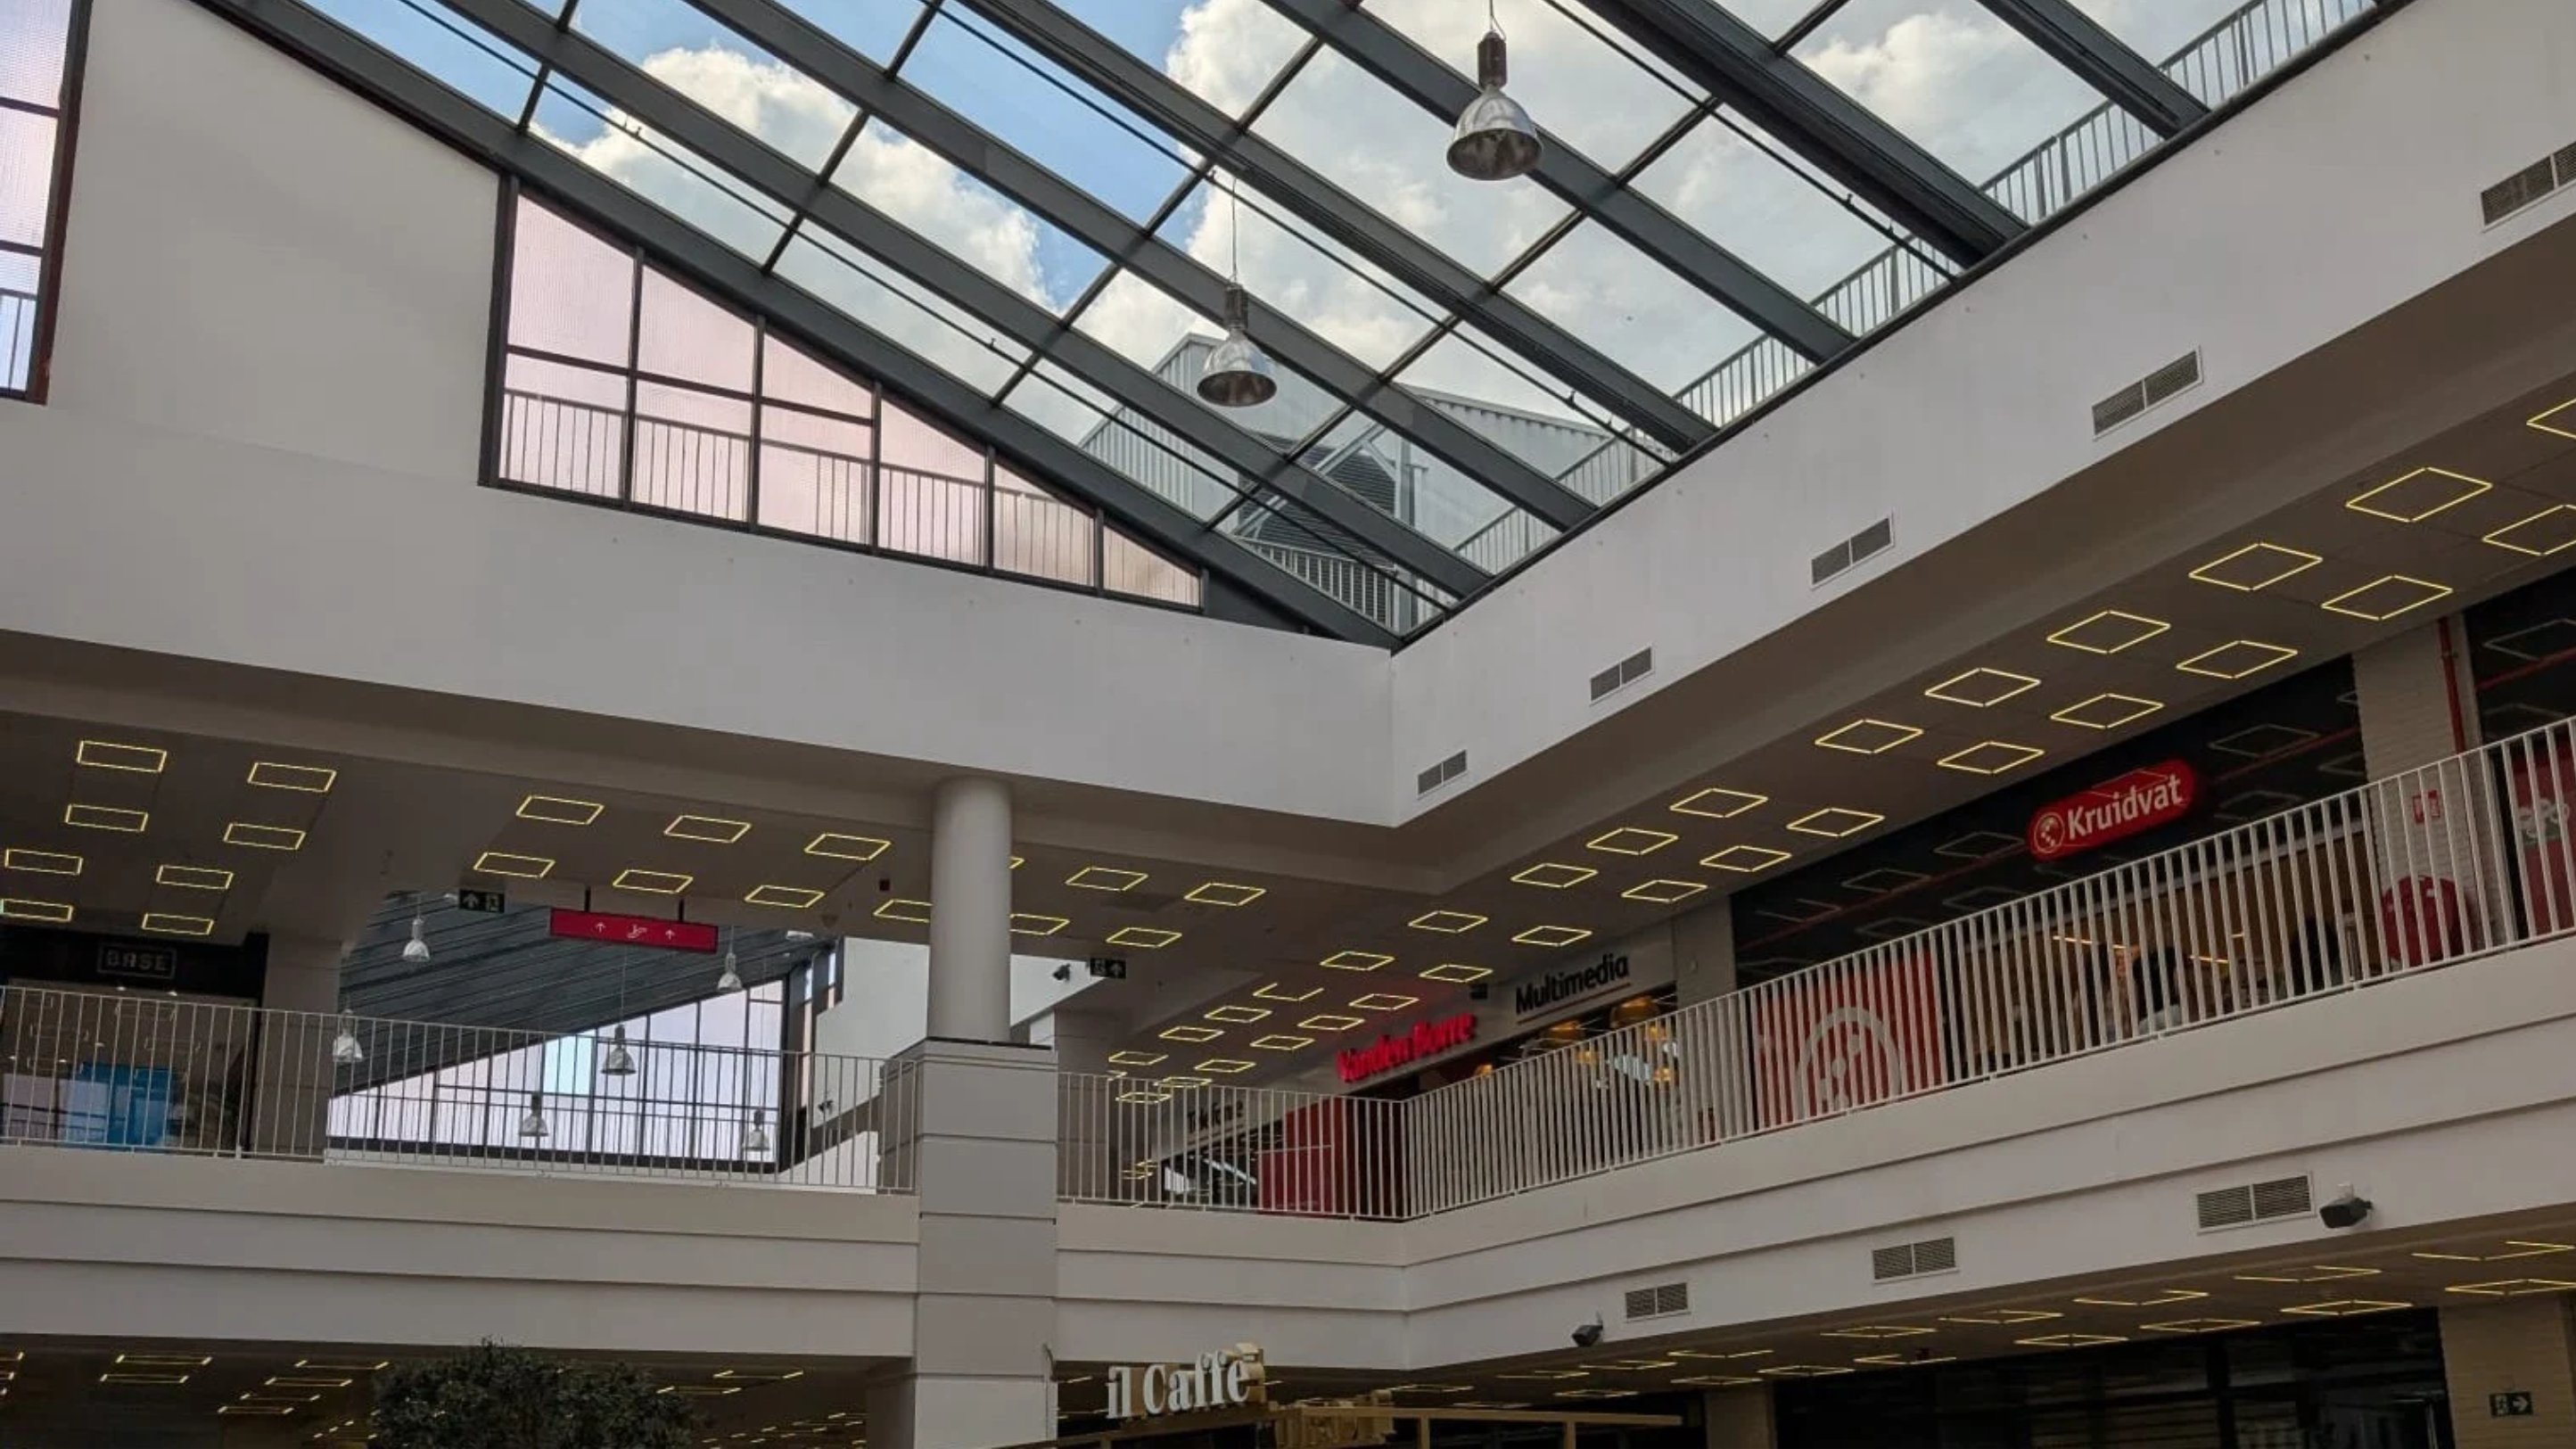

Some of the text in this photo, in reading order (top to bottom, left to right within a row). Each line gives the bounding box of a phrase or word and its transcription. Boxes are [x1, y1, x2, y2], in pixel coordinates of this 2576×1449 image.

[2067, 773, 2184, 840] Kruidvat
[106, 949, 168, 971] BASE
[1516, 952, 1630, 1015] Multimedia
[1106, 1365, 1133, 1420] il
